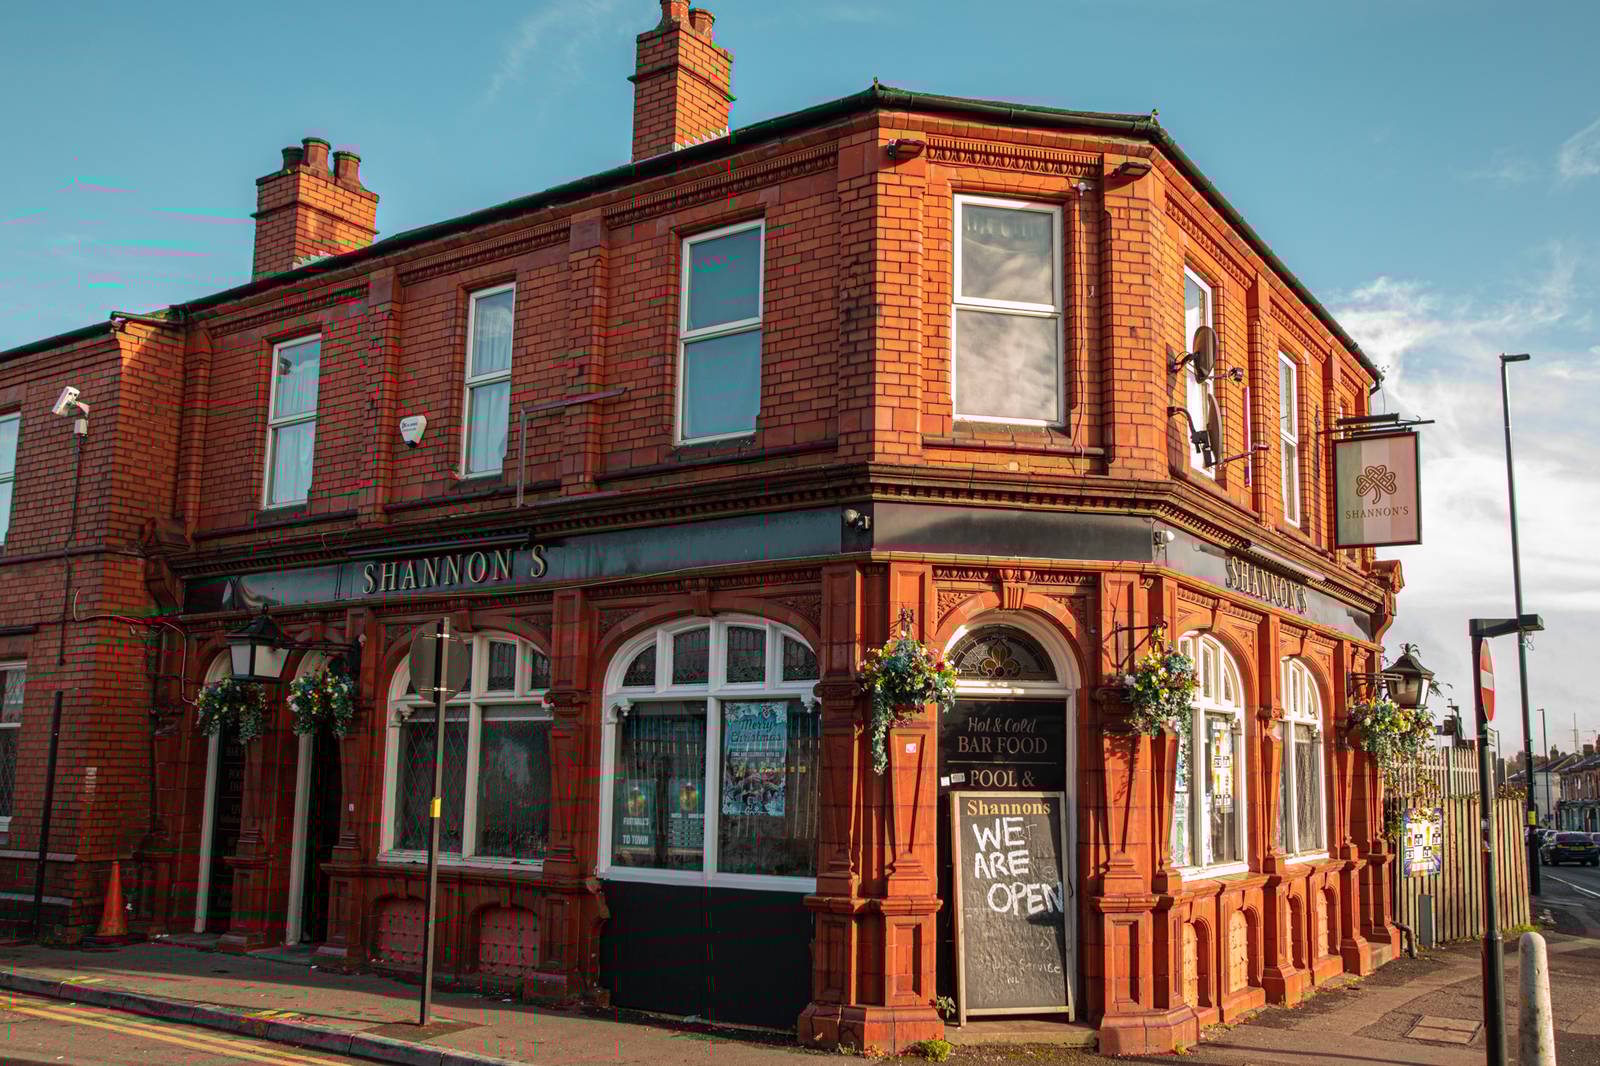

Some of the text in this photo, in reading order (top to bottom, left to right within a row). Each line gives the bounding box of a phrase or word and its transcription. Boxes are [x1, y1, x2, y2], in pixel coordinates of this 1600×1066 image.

[1345, 506, 1409, 520] SHANNON'S
[968, 717, 1037, 733] Hot & Cold
[958, 735, 1047, 754] BAR FOOD
[970, 769, 1018, 788] POOL
[1022, 770, 1036, 787] &
[967, 799, 1051, 816] Shannons
[972, 816, 1025, 852] WE
[974, 849, 1030, 879] ARE
[987, 881, 1064, 916] OPEN
